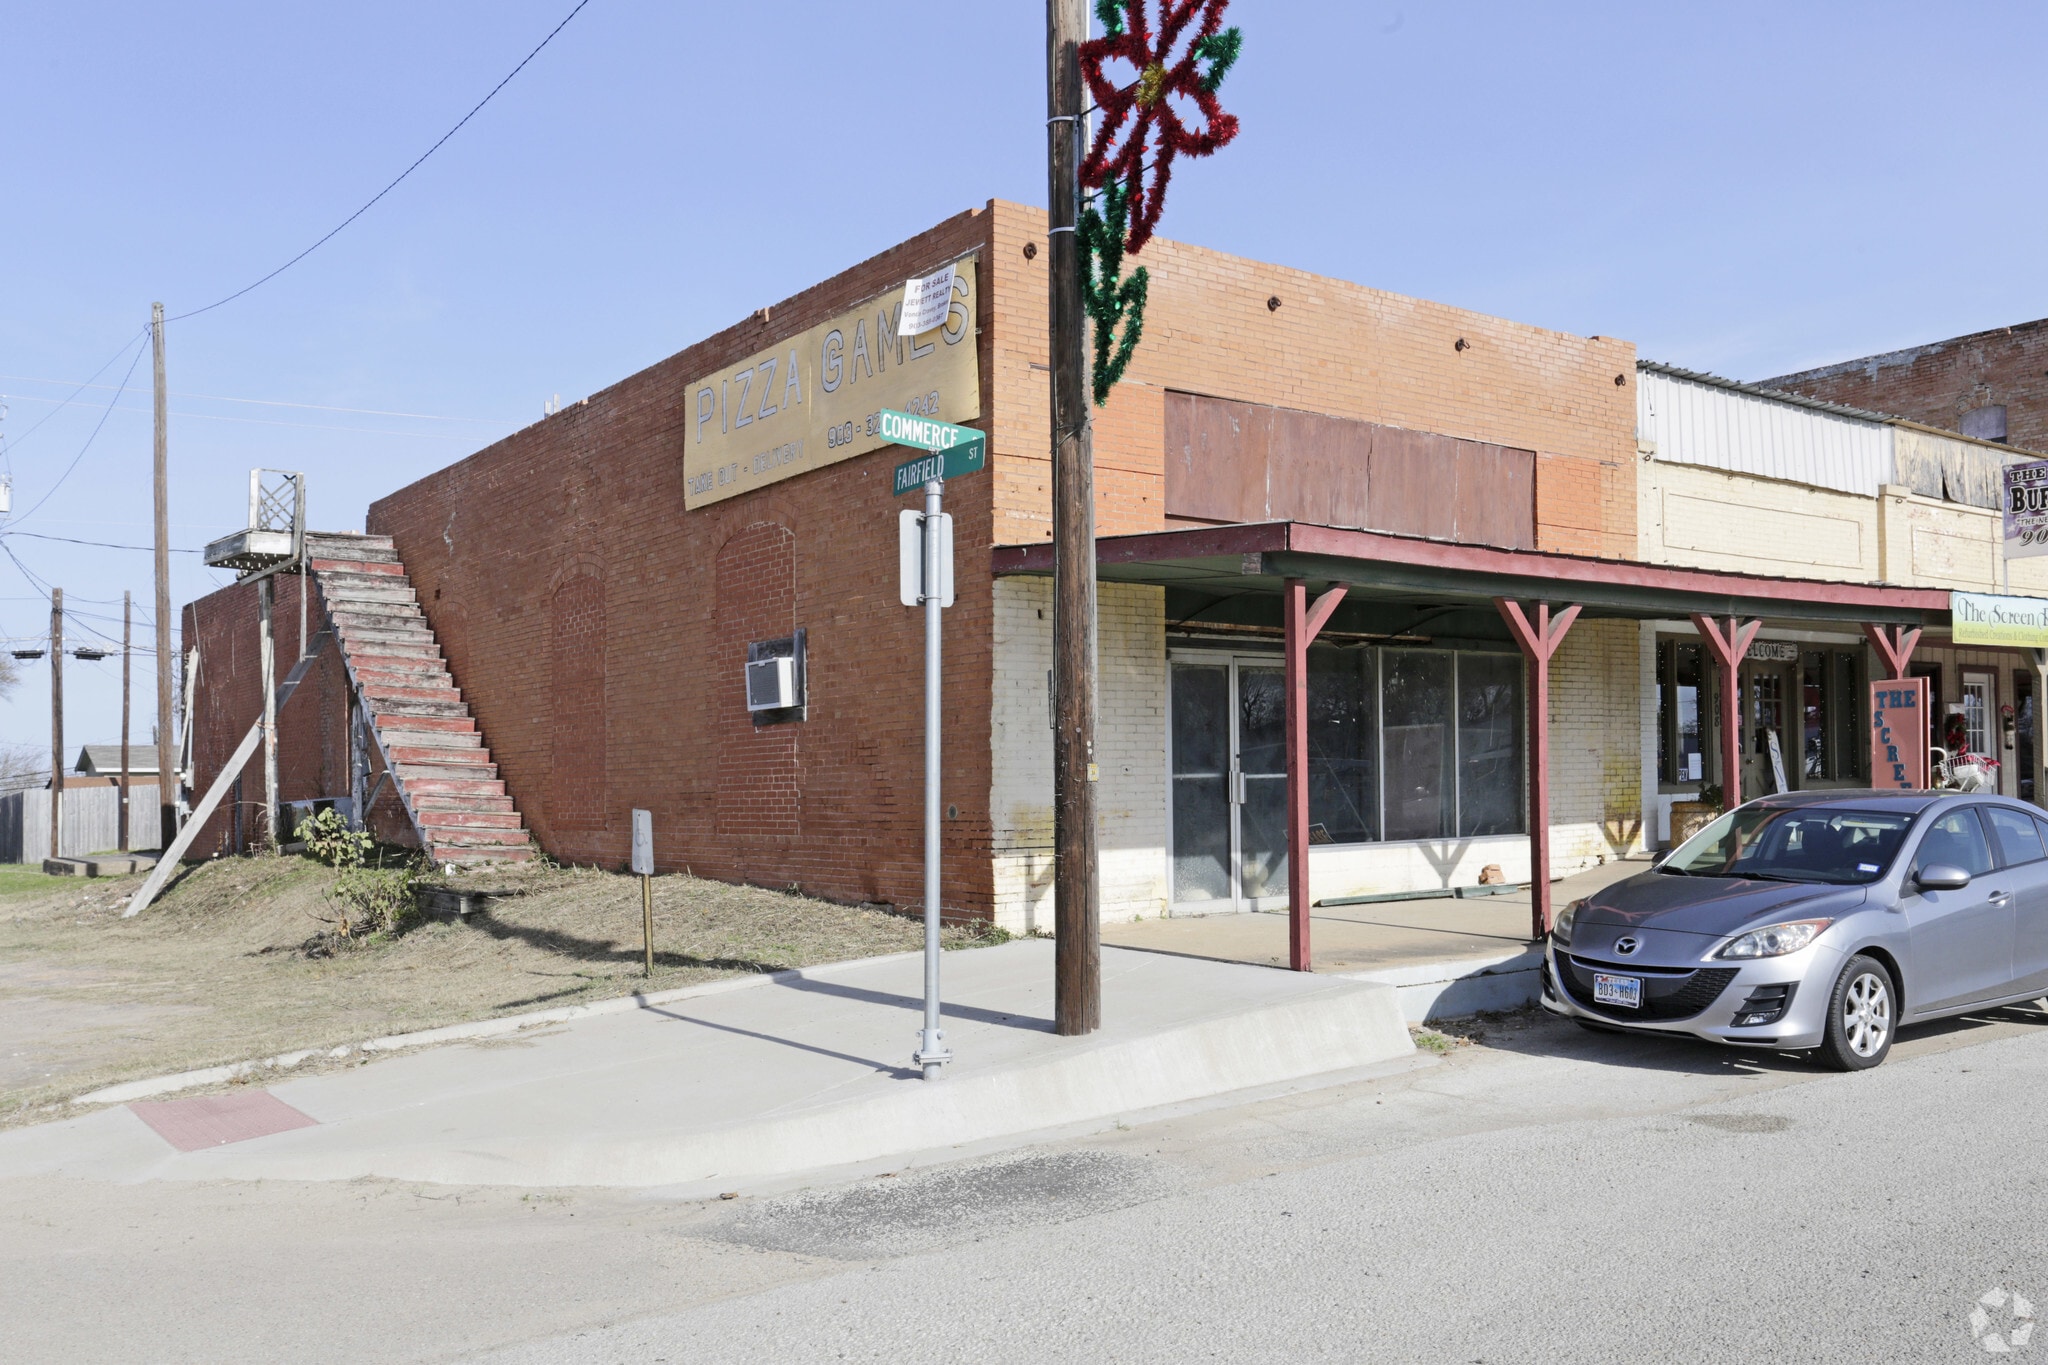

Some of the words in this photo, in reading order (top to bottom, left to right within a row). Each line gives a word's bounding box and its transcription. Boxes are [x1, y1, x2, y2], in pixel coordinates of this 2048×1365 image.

[914, 281, 931, 294] FOR
[932, 273, 949, 288] SALE
[932, 285, 951, 300] REALTY
[696, 348, 802, 444] PIZZA
[828, 420, 853, 448] 903
[688, 471, 713, 496] TAKE
[718, 462, 738, 486] OUT
[753, 438, 805, 476] DELIVERY
[896, 453, 945, 491] FAIRFIELD
[968, 446, 978, 460] ST
[2009, 466, 2047, 483] THE
[1958, 597, 1986, 622] The
[1989, 604, 2035, 629] Screen
[1747, 643, 1785, 658] ELCOME
[1876, 690, 1916, 709] THE
